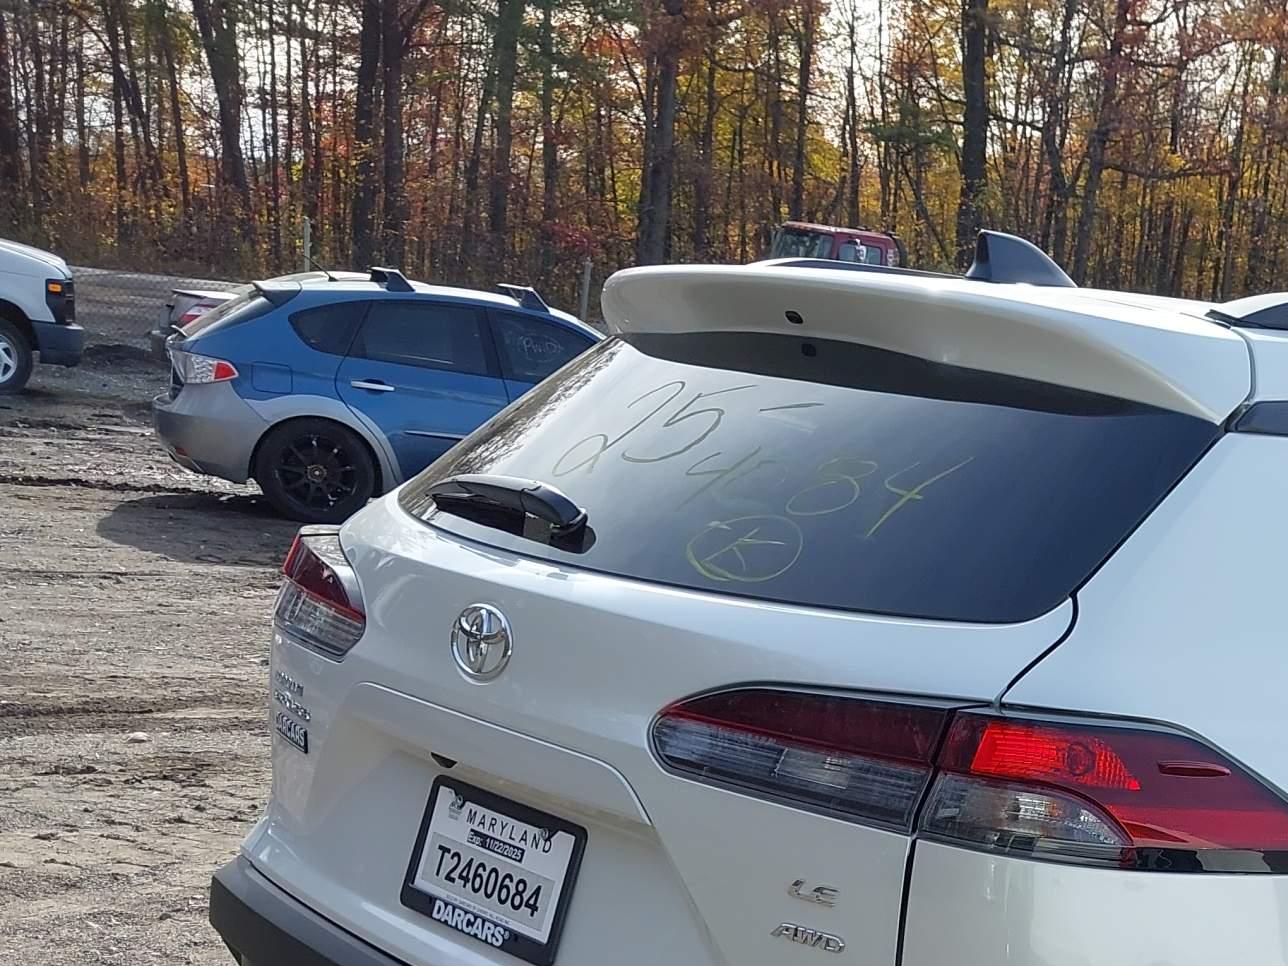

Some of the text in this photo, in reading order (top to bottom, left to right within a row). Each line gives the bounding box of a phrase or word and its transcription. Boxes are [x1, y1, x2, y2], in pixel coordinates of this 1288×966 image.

[466, 808, 552, 853] MARYLAND
[435, 844, 542, 917] T2460684
[789, 880, 840, 907] LE
[432, 899, 504, 947] DARCARS
[770, 922, 845, 953] AWD
